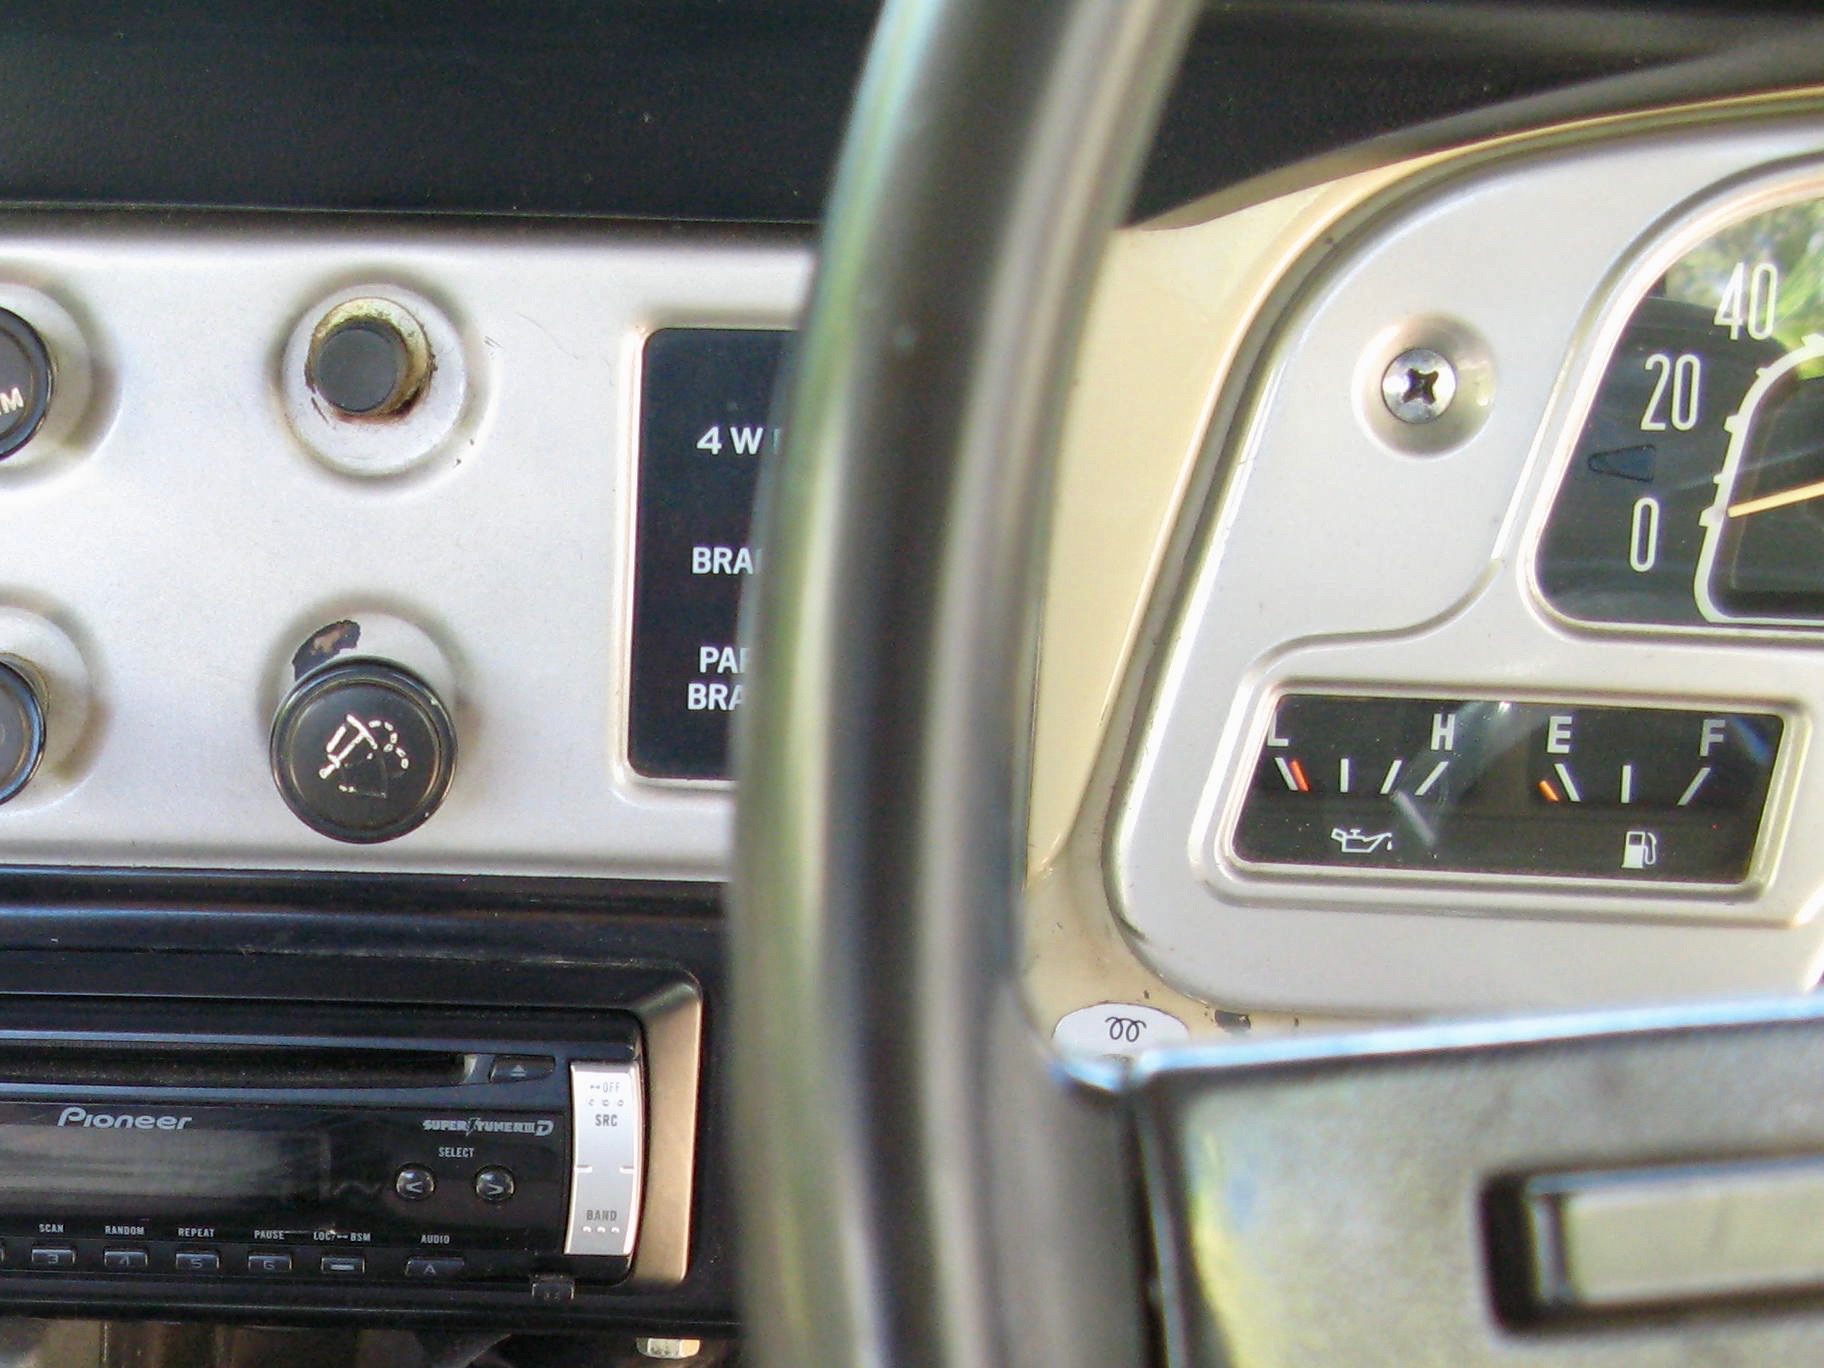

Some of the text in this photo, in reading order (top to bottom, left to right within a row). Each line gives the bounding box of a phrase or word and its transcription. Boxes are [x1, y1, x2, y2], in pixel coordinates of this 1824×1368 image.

[1713, 262, 1778, 340] 40
[1640, 354, 1701, 431] 20
[1629, 497, 1660, 573] 0
[1267, 712, 1457, 751] L H
[1547, 715, 1726, 757] E F
[602, 1081, 620, 1094] OFF
[57, 1106, 192, 1130] Pioneer
[594, 1114, 618, 1127] SRC
[438, 1147, 474, 1158] SELECT
[586, 1210, 617, 1222] BAND
[38, 1223, 64, 1233] SCAN
[105, 1225, 145, 1236] RANDOM
[178, 1227, 215, 1238] REPEAT
[254, 1230, 285, 1240] PAUSE
[420, 1234, 450, 1245] AUDIO
[47, 1254, 59, 1264] 3
